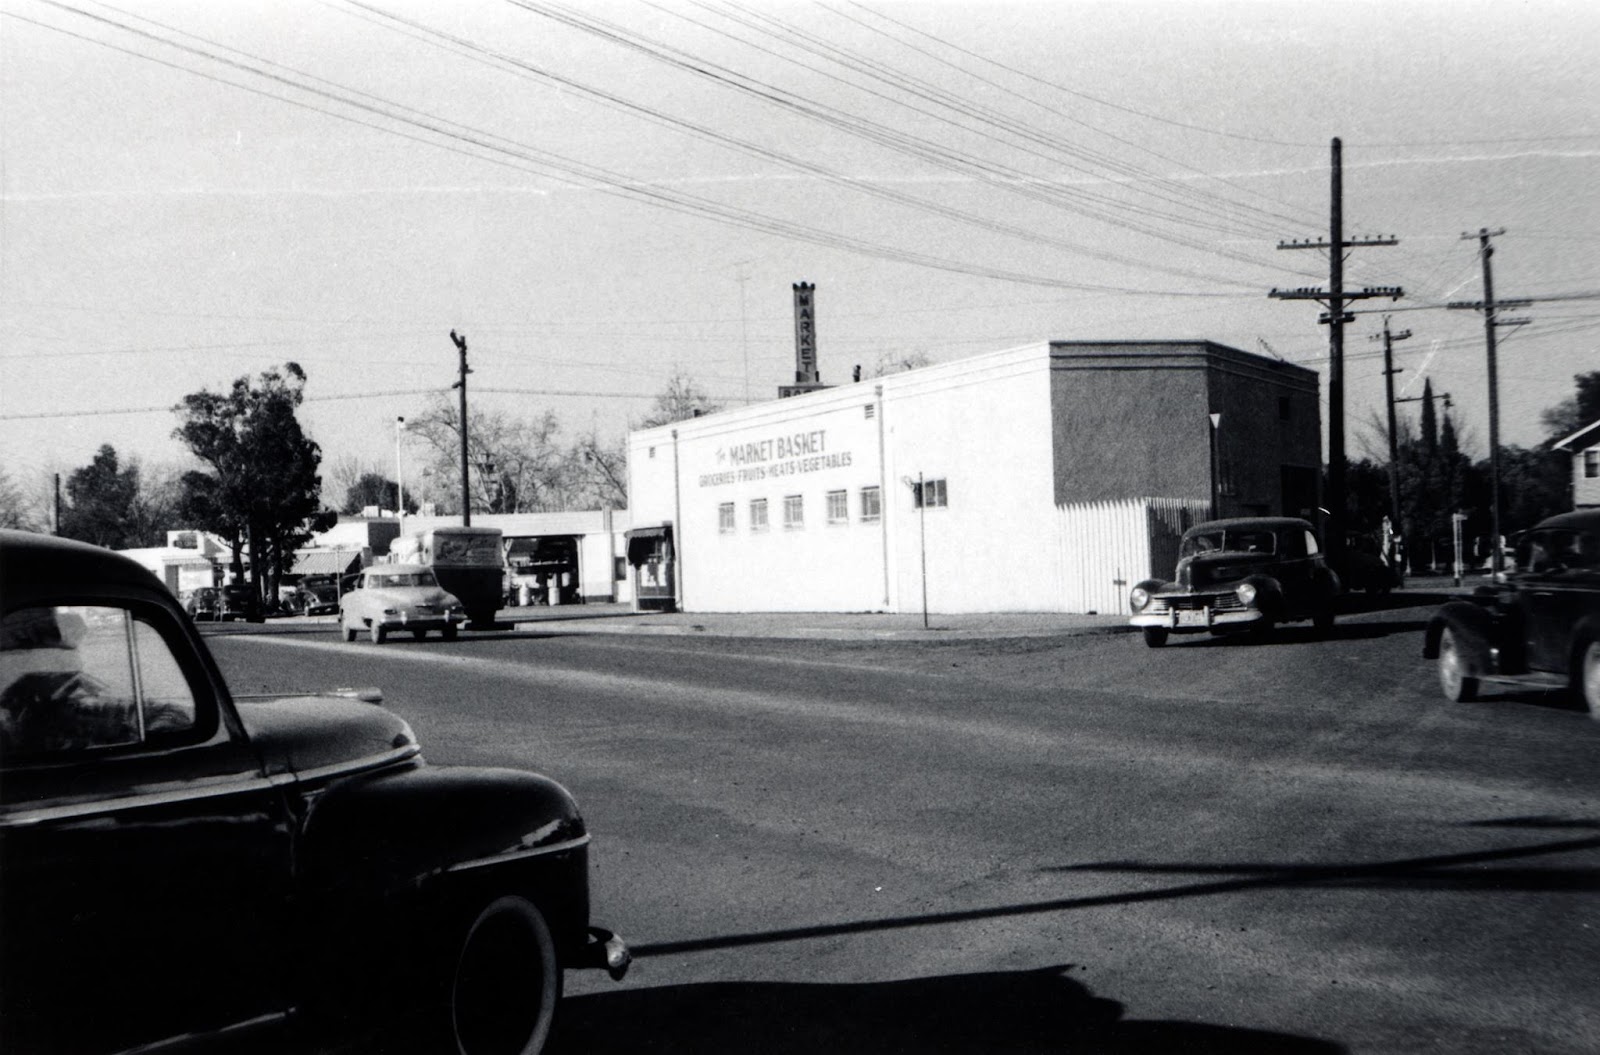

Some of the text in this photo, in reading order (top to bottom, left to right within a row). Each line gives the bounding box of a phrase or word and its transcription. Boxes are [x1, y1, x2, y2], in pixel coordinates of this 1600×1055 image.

[799, 295, 812, 373] MARKET
[730, 439, 773, 466] MARKET
[777, 430, 826, 459] BASKET
[737, 466, 766, 482] FRUITS
[768, 460, 795, 478] MEATS
[797, 451, 853, 473] VEGETABLES
